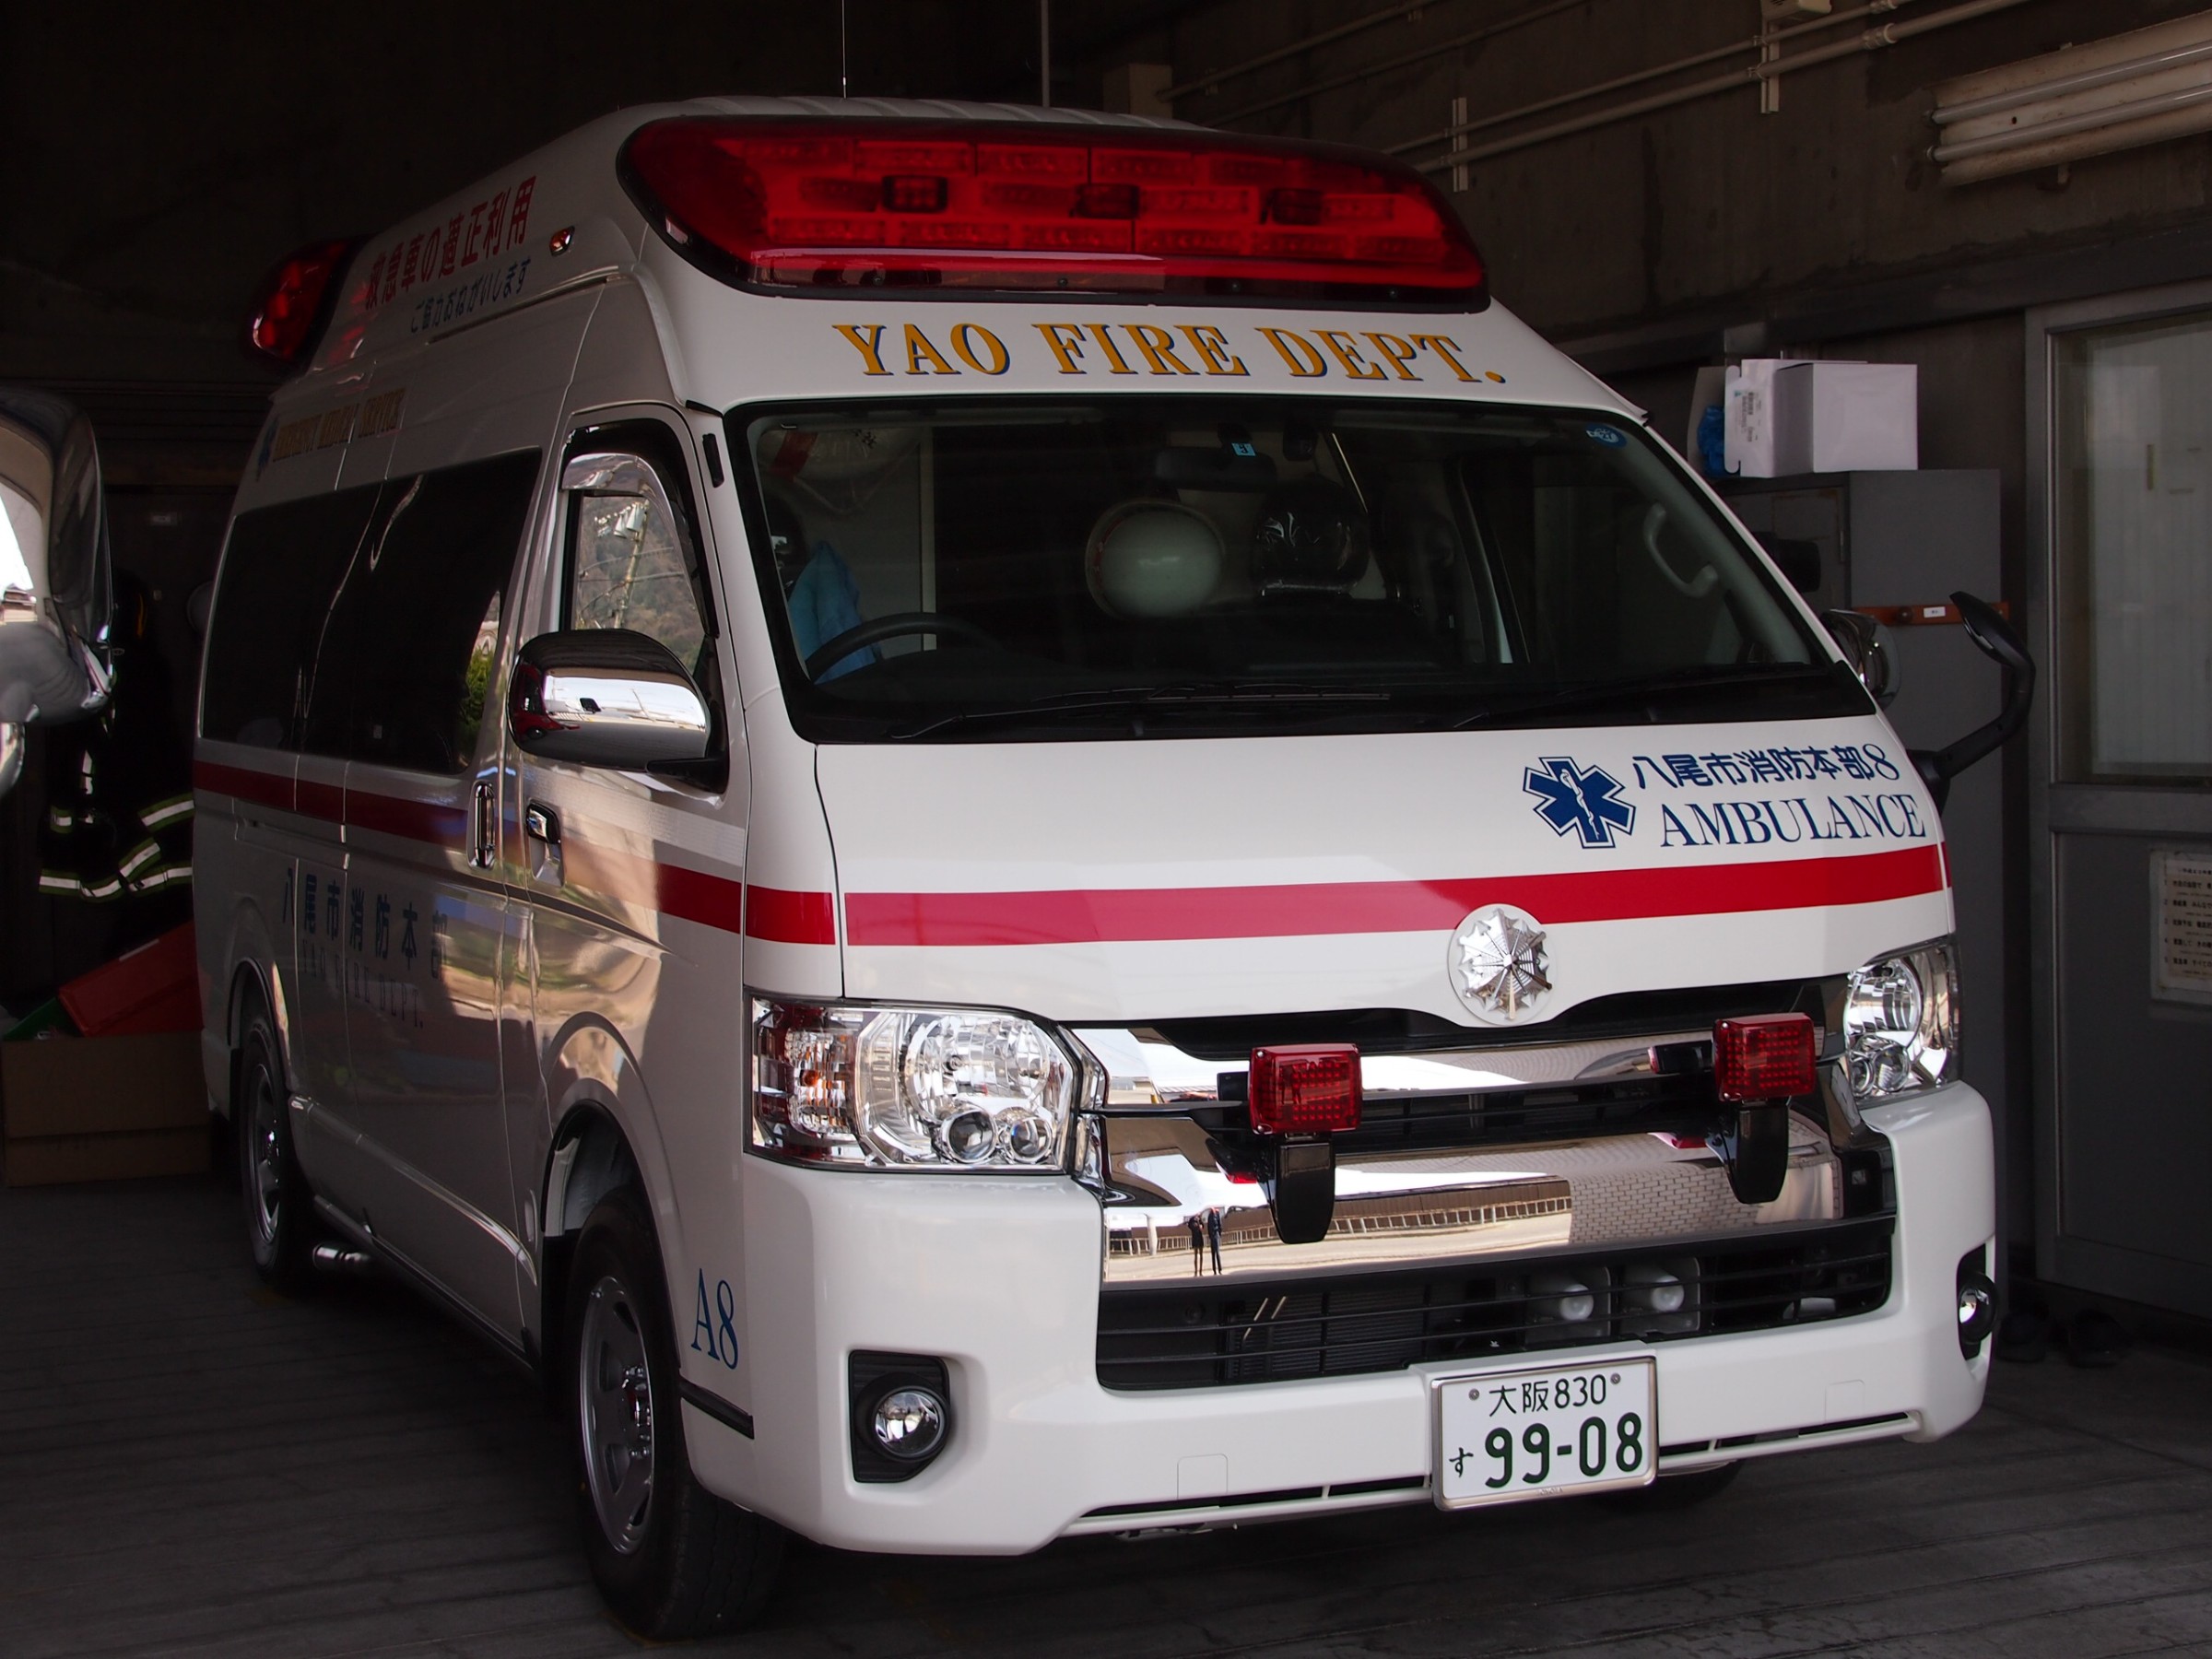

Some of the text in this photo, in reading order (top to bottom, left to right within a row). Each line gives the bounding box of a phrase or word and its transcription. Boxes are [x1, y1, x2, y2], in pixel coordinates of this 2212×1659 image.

[366, 175, 536, 310] 救急車の適正利用
[831, 324, 1506, 383] YAO FIRE DEPT.
[1660, 794, 1926, 847] AMBULANCE
[283, 867, 448, 979] 八尾市消防本部
[691, 1267, 738, 1370] A8
[1449, 1412, 1642, 1488] す 99-08
